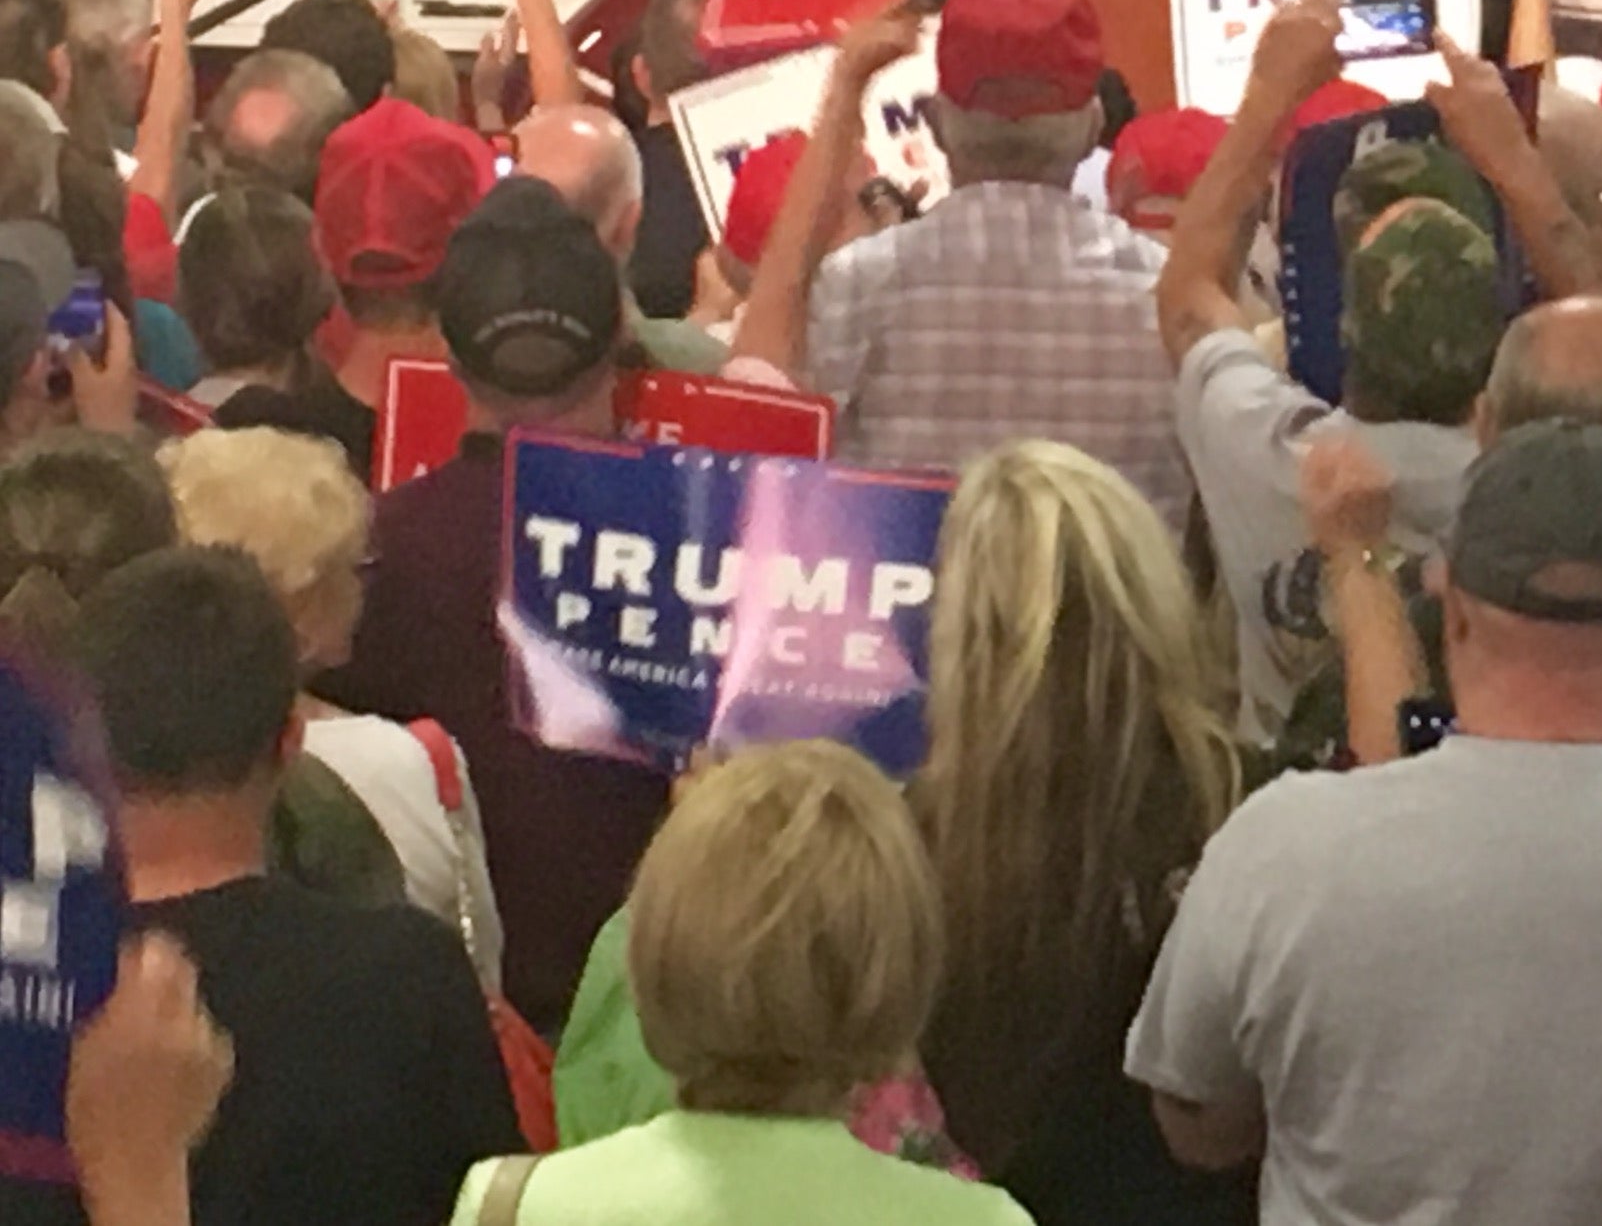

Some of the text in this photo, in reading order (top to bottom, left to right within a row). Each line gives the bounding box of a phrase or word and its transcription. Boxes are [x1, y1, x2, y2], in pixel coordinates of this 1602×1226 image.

[524, 514, 934, 620] TRUMP
[555, 591, 885, 671] PENCE
[608, 657, 708, 690] AMERICA
